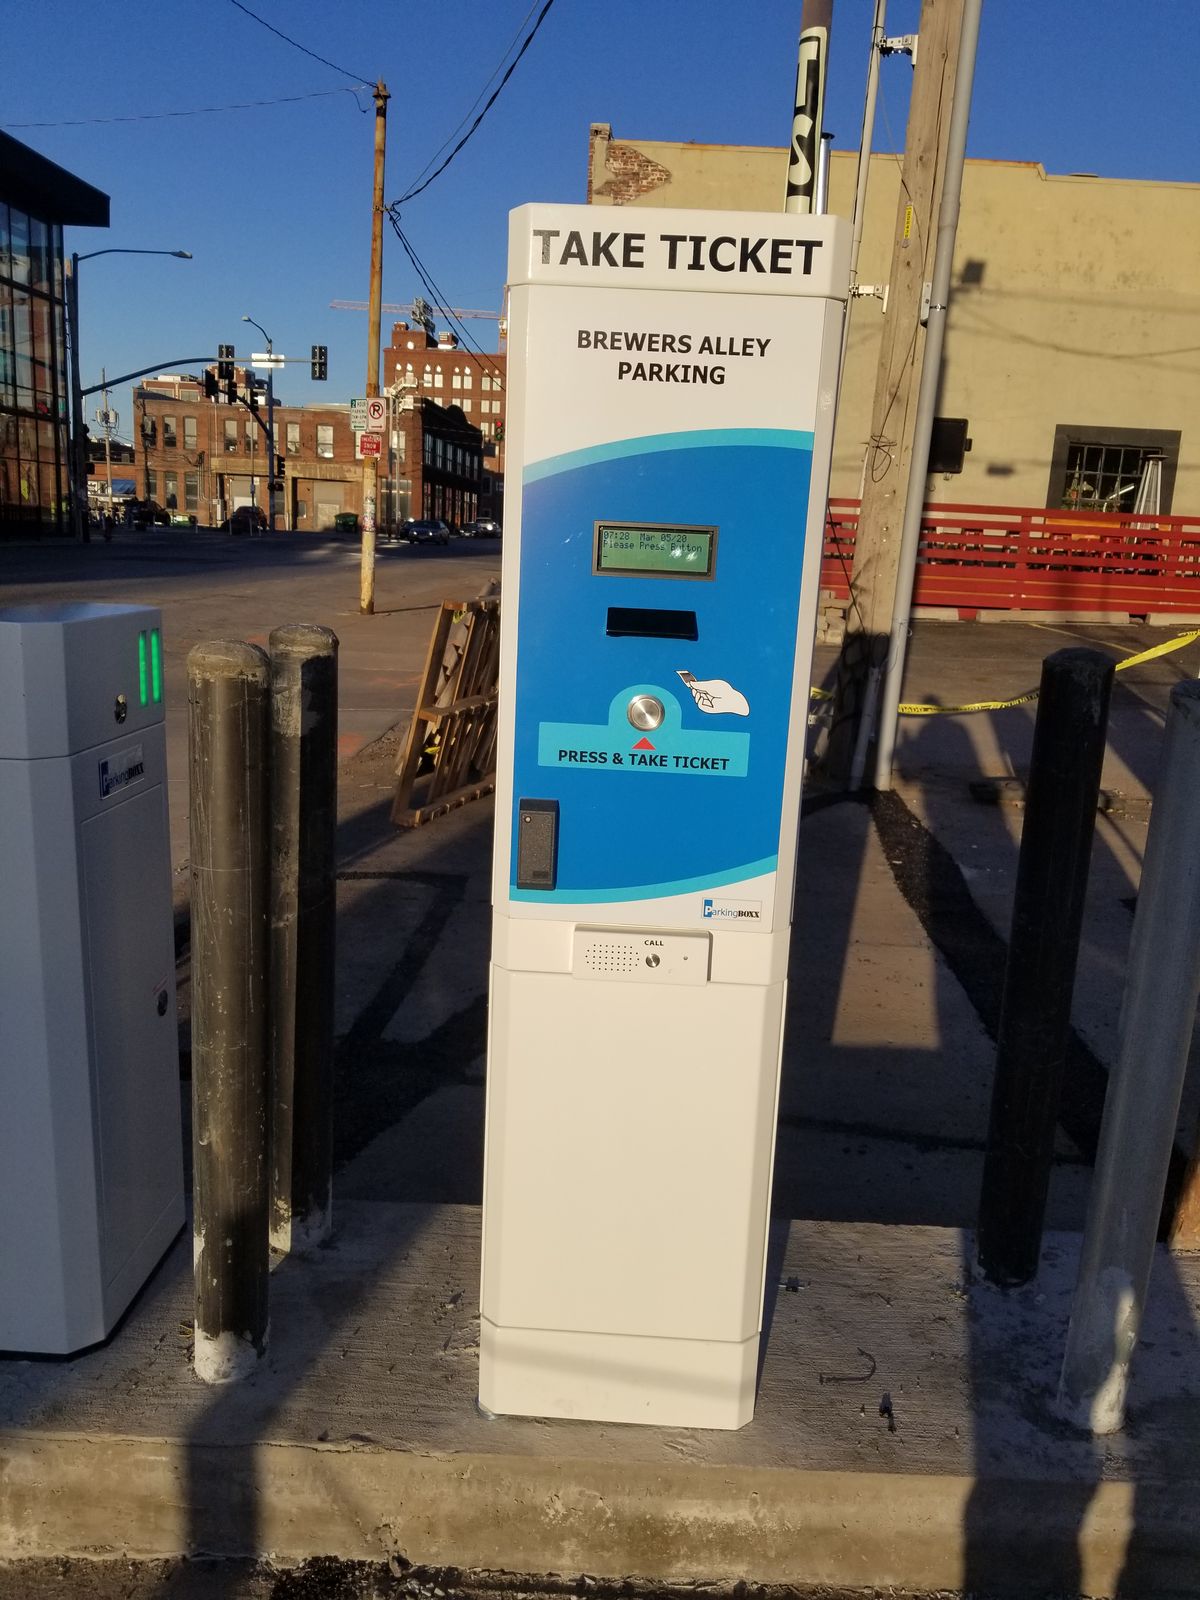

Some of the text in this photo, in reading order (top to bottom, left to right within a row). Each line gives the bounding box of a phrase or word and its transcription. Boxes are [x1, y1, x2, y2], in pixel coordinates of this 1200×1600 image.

[532, 229, 823, 275] TAKE TICKET
[577, 330, 771, 357] BREWERS ALLEY
[618, 361, 726, 385] PARKING
[603, 531, 630, 541] 07:28
[640, 533, 655, 542] Mar
[603, 540, 634, 549] Please
[640, 542, 665, 551] Press
[558, 750, 729, 770] PRESS & TAKE TICKET
